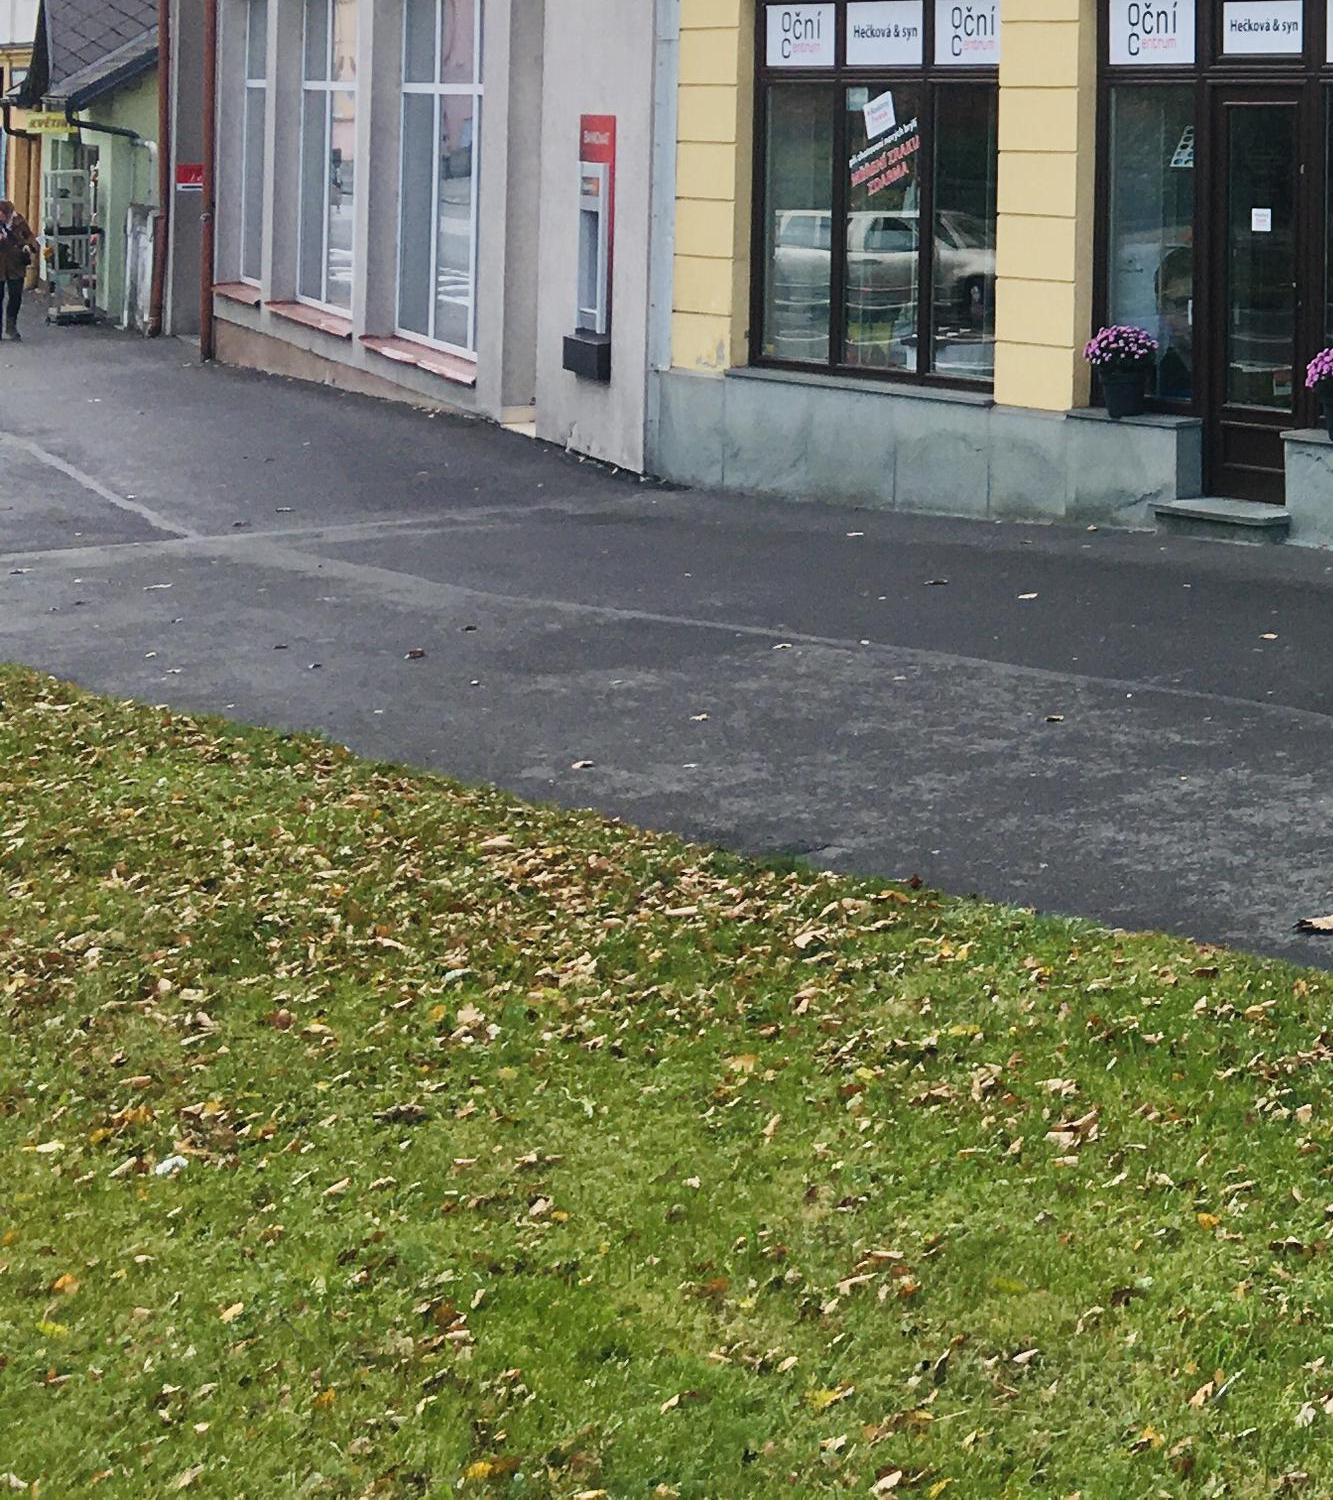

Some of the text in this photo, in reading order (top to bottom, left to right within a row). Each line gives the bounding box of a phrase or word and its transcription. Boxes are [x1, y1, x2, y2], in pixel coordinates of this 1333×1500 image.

[782, 10, 822, 40] Oční
[853, 23, 918, 41] Hečková & syn
[951, 6, 996, 37] Oční
[1128, 1, 1178, 35] Oční
[1230, 18, 1299, 35] Hečková & syn
